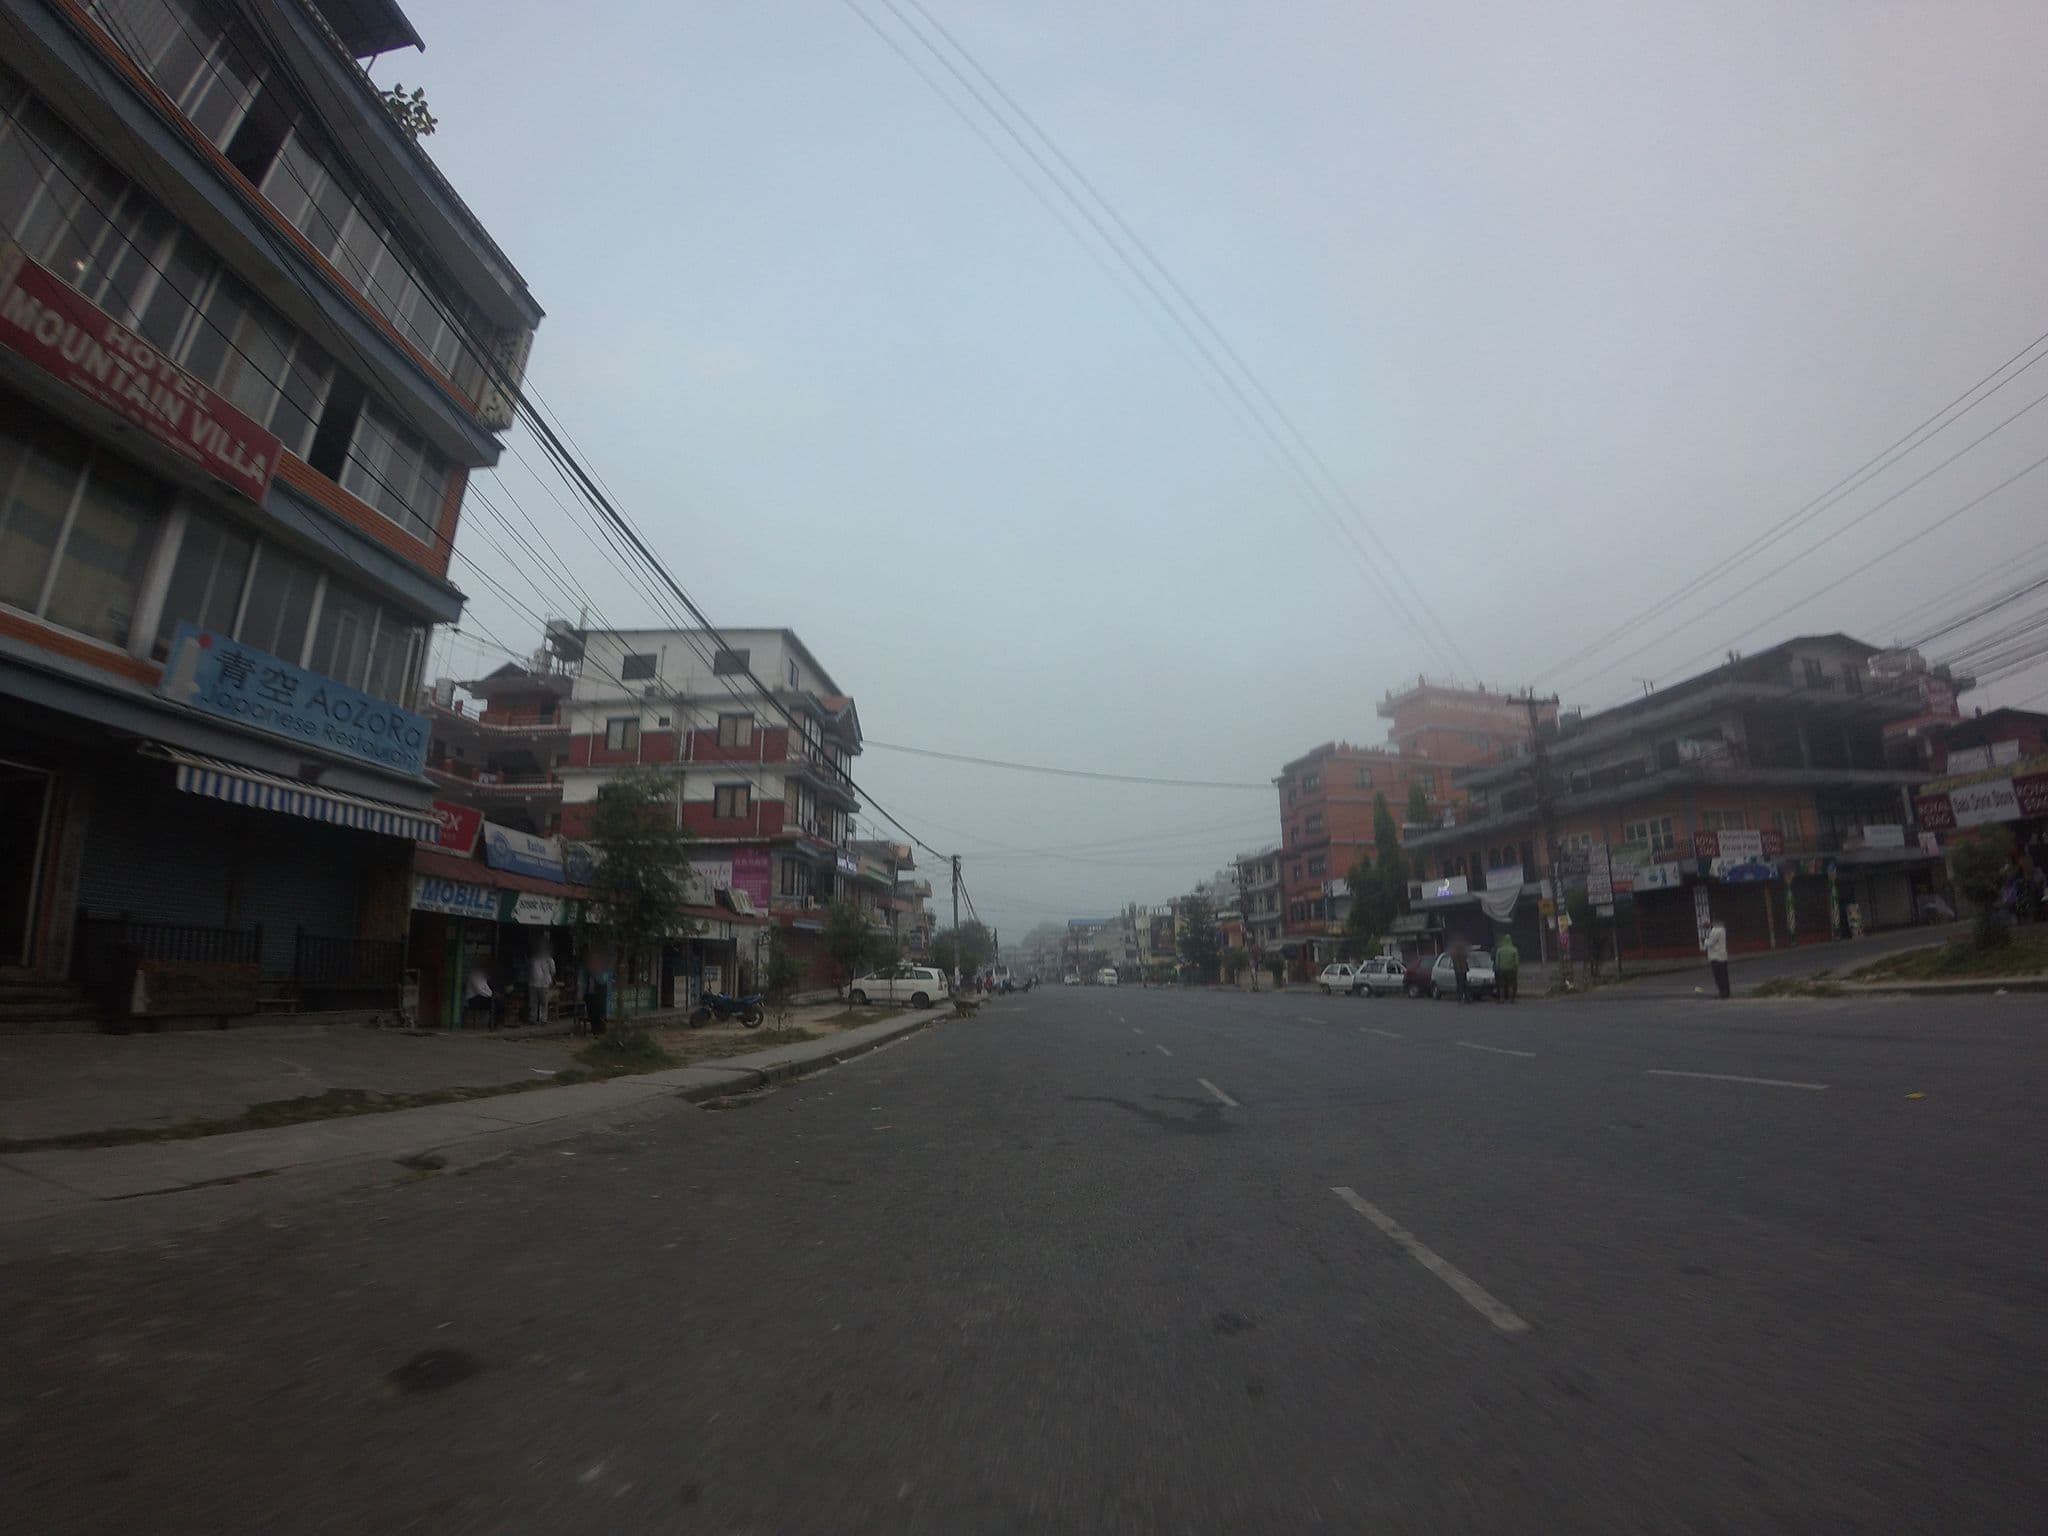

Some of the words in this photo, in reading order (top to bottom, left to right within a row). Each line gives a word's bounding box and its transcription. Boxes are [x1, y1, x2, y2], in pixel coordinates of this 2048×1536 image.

[2, 287, 187, 433] MOUNTAIN
[192, 409, 267, 487] VILLA
[104, 324, 211, 413] HOTEL
[216, 648, 298, 708] 青空
[201, 686, 317, 737] Japanese
[421, 878, 498, 911] MOBILE
